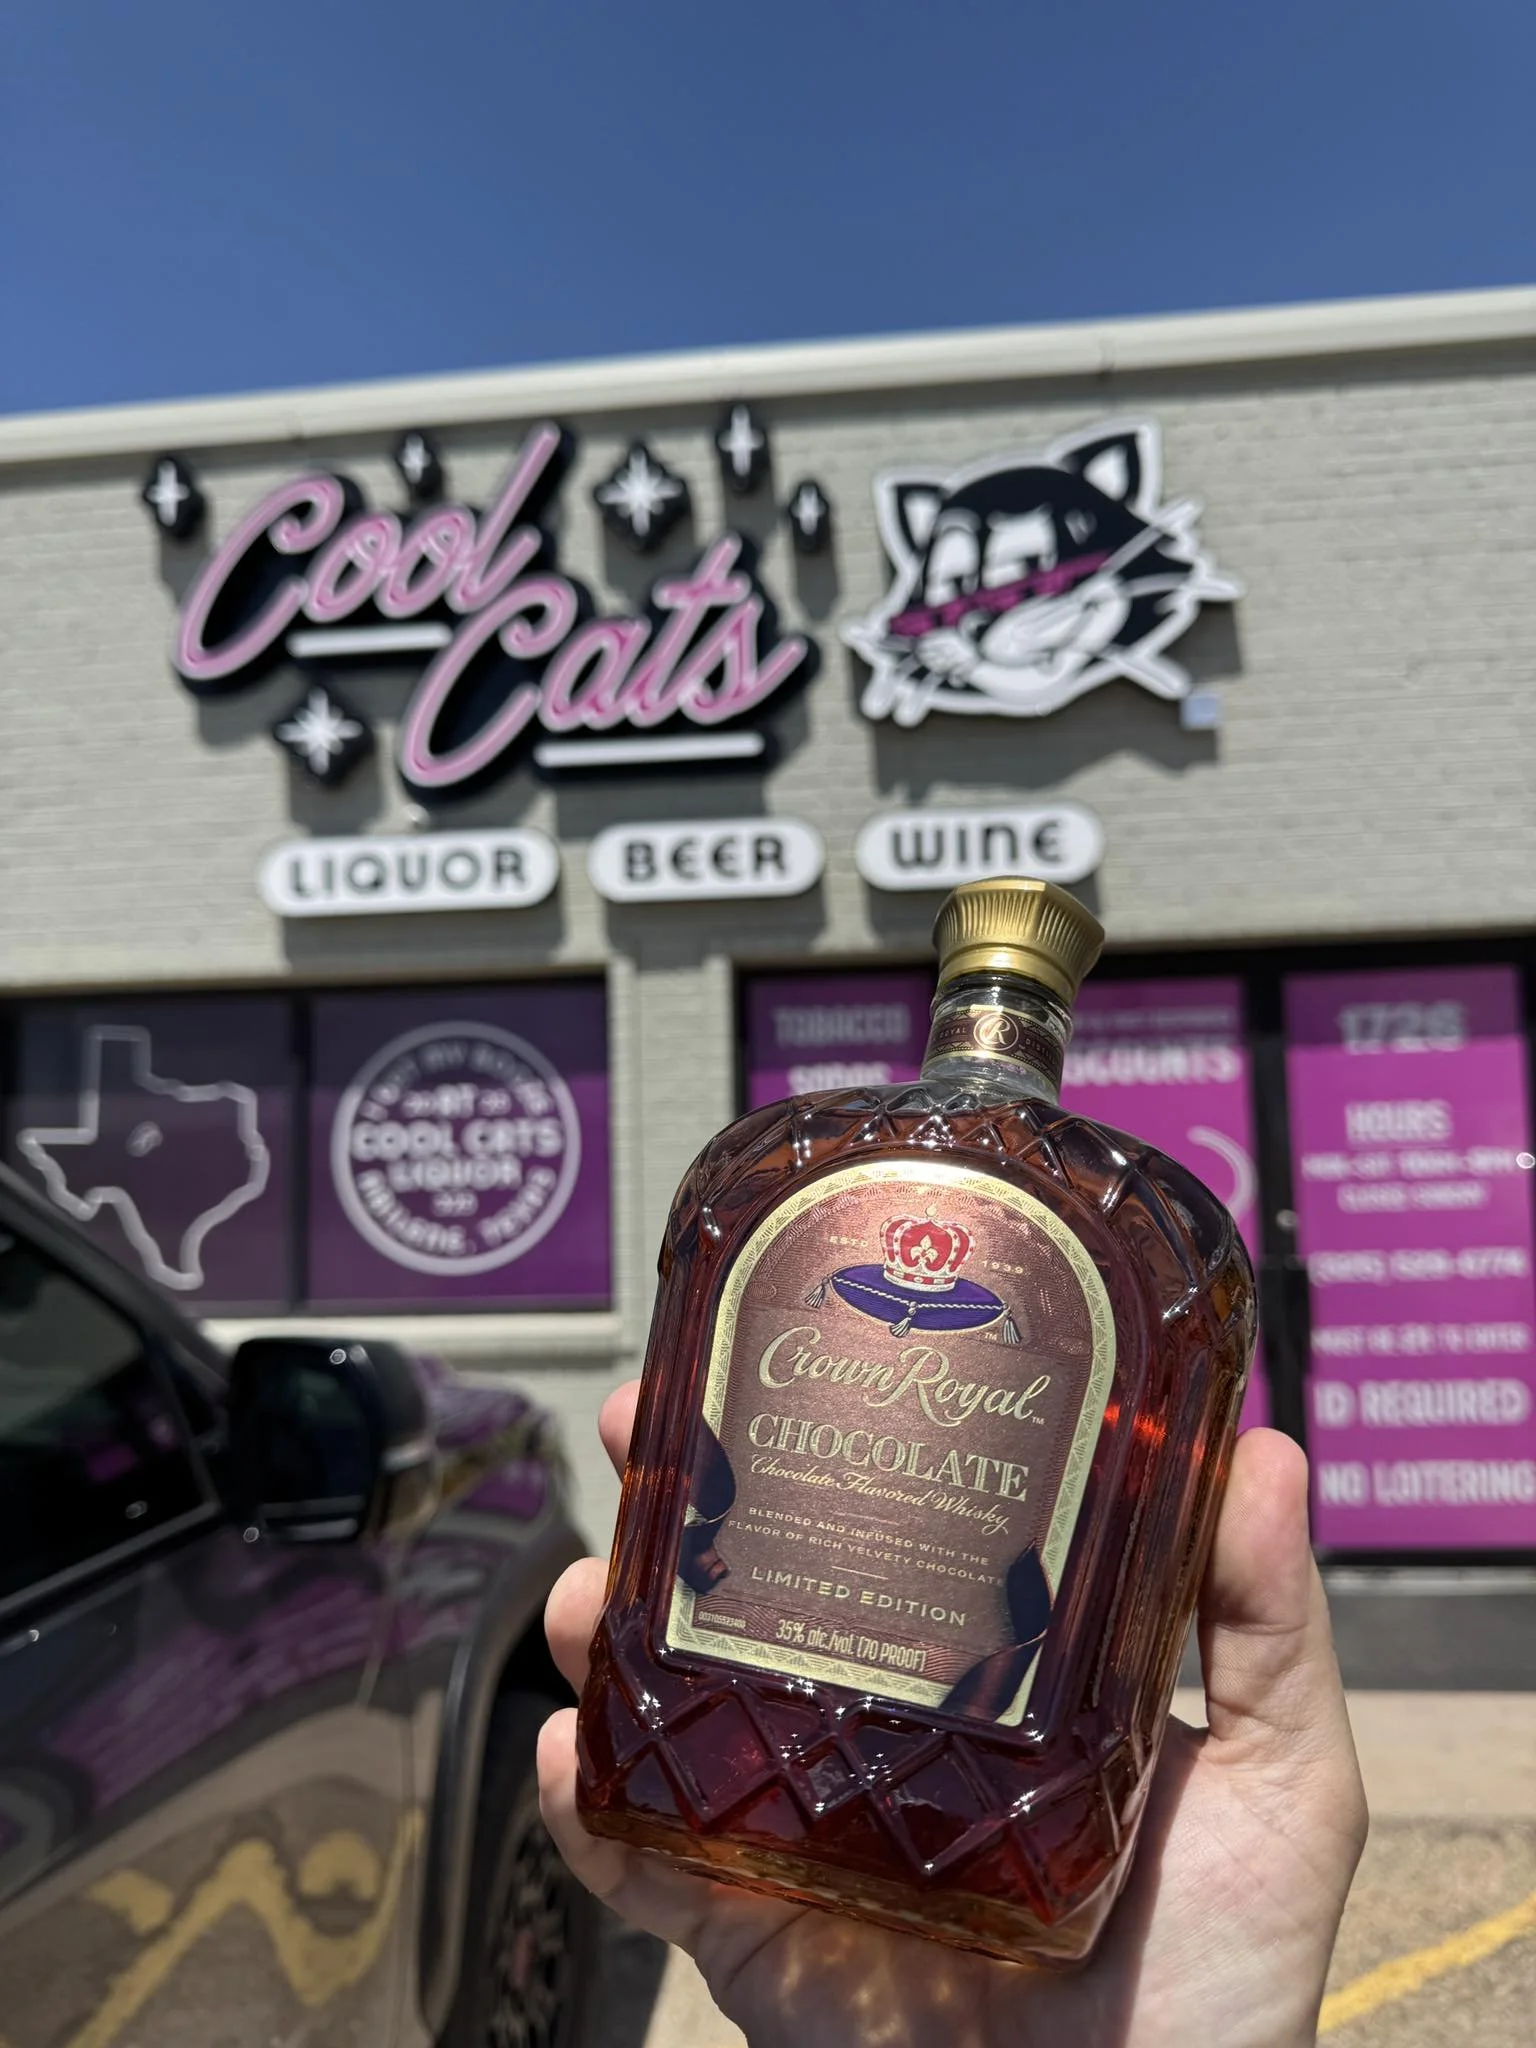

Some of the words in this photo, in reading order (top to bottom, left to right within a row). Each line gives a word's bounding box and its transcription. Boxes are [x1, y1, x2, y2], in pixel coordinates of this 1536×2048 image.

[178, 423, 559, 680] Cool
[401, 534, 808, 788] Cats
[622, 833, 788, 884] BEER
[891, 819, 1067, 870] WINE
[288, 848, 527, 899] LIQUOR
[351, 1121, 457, 1161] COOL
[462, 1118, 565, 1157] CATS
[1345, 1100, 1454, 1144] HOURS
[388, 1154, 522, 1192] LIQUOR
[981, 1259, 1026, 1276] 1939
[757, 1325, 895, 1392] Crown
[862, 1345, 1052, 1428] Royal
[1358, 1377, 1533, 1427] REQUIRED
[747, 1412, 1030, 1502] CHOCOLATE
[1318, 1460, 1371, 1508] NO
[1371, 1457, 1536, 1508] LOITERING
[750, 1453, 836, 1487] Chocolate
[836, 1471, 935, 1507] Flavored
[930, 1490, 1011, 1537] Whisky
[727, 1520, 782, 1538] FLAVOR
[784, 1530, 805, 1542] OF
[808, 1535, 843, 1550] RICH
[846, 1543, 913, 1566] VELVETY
[748, 1506, 813, 1527] BLENDED
[815, 1520, 847, 1534] AND
[849, 1526, 914, 1549] INFUSED
[918, 1542, 957, 1559] WITH
[960, 1552, 991, 1567] THE
[750, 1565, 851, 1599] LIMITED
[859, 1589, 967, 1627] EDITION
[775, 1618, 806, 1644] 35%
